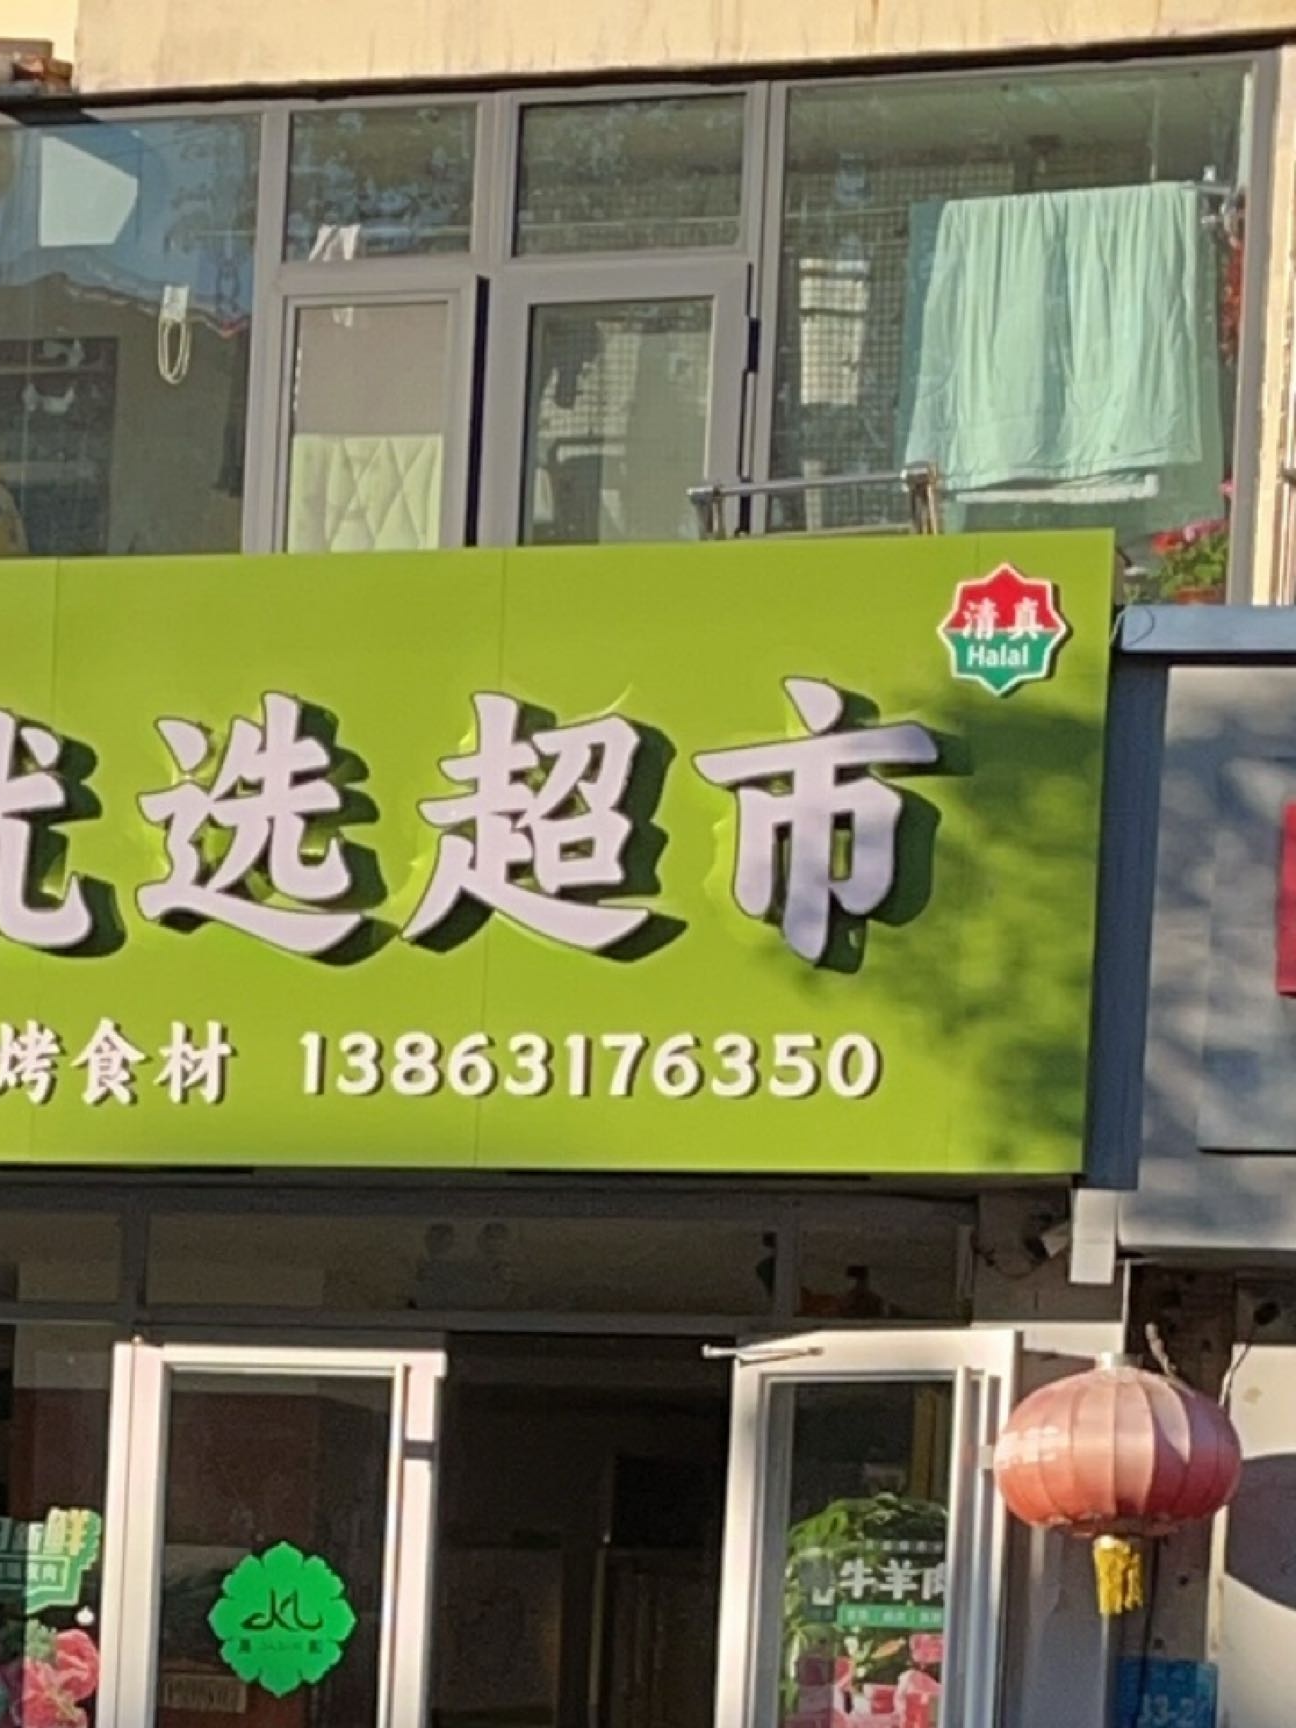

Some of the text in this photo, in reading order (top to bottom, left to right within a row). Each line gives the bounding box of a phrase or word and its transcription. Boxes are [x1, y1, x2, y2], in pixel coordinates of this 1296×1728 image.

[962, 597, 1044, 640] 清真
[966, 643, 1029, 667] Halal
[299, 1029, 883, 1097] 13863176350
